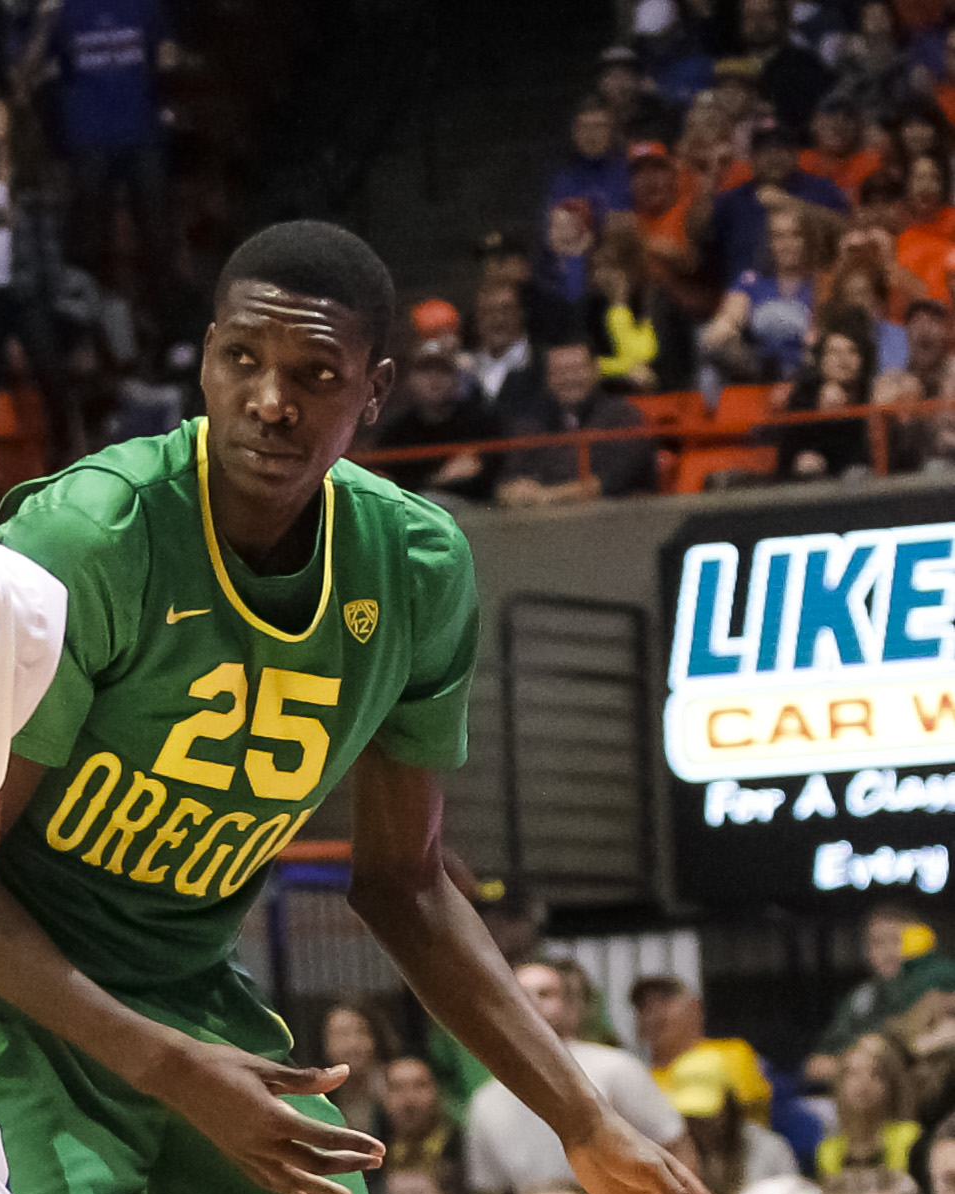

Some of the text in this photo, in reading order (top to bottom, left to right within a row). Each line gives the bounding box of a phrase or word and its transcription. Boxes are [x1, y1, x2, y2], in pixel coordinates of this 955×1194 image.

[347, 601, 376, 627] PAC
[354, 616, 371, 634] 12
[686, 537, 955, 680] LIKE
[151, 662, 342, 801] 25
[706, 697, 875, 749] CAR
[703, 779, 786, 828] For
[792, 772, 838, 821] A
[813, 839, 950, 894] Every
